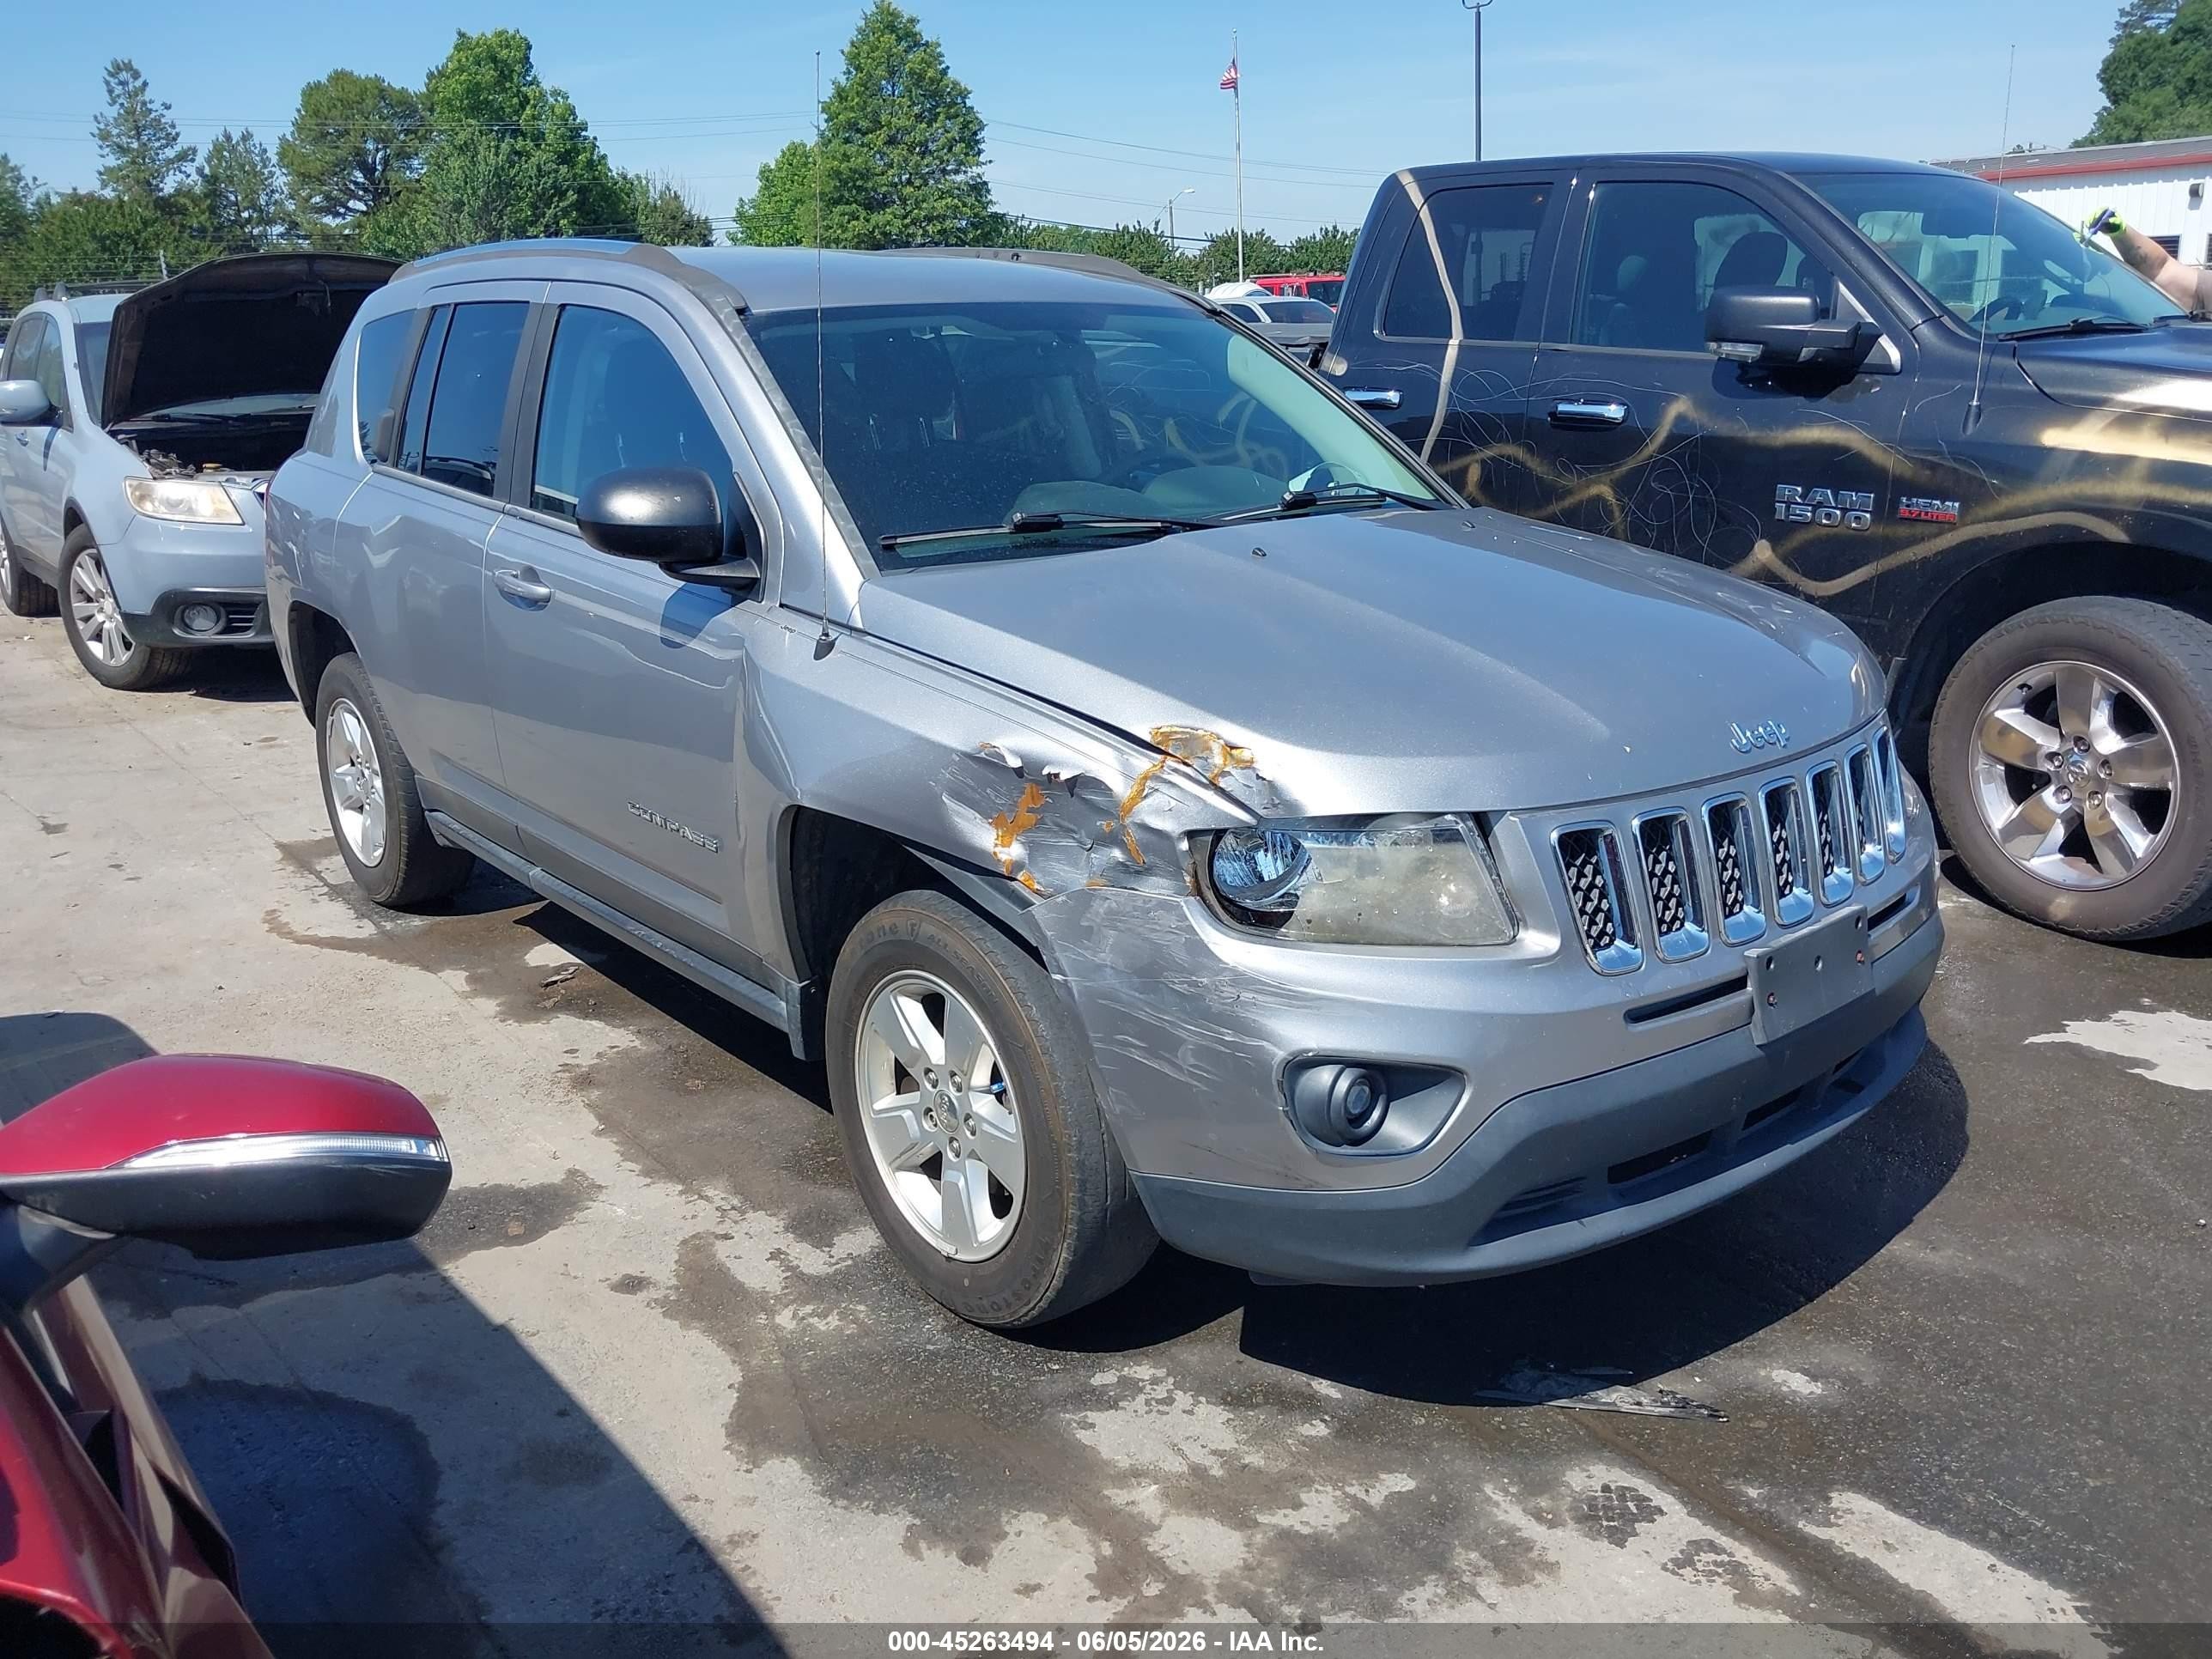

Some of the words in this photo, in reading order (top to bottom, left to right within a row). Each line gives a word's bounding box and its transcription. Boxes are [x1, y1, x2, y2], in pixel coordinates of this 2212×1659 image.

[1775, 484, 1875, 511] RAM
[1899, 496, 1960, 513] HEMI
[1775, 502, 1871, 531] 1500
[1921, 512, 1956, 522] LITER
[1729, 720, 1789, 753] Jeep
[627, 800, 719, 854] COMPASS
